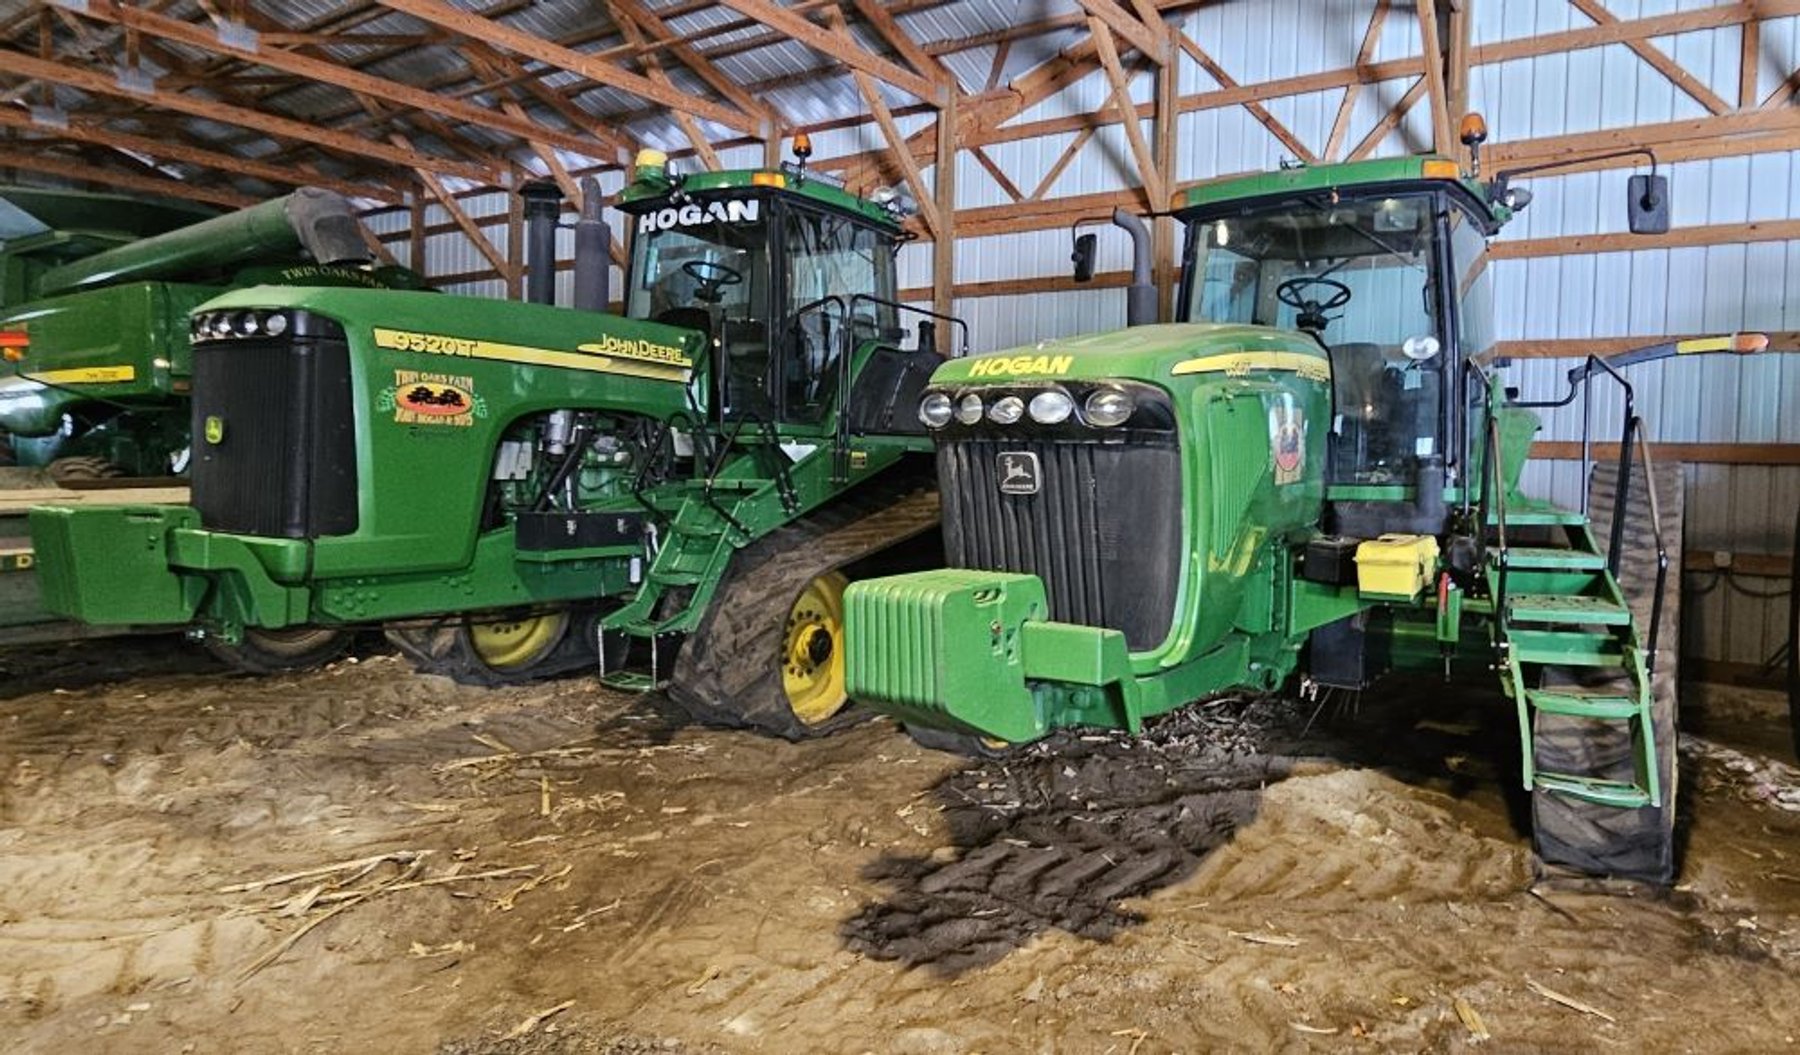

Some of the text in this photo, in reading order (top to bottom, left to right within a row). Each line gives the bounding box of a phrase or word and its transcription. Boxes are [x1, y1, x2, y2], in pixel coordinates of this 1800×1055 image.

[639, 199, 759, 234] HOGAN
[394, 331, 478, 358] 9520T
[600, 333, 683, 362] JOHN DEERE
[968, 356, 1073, 377] HOGAN
